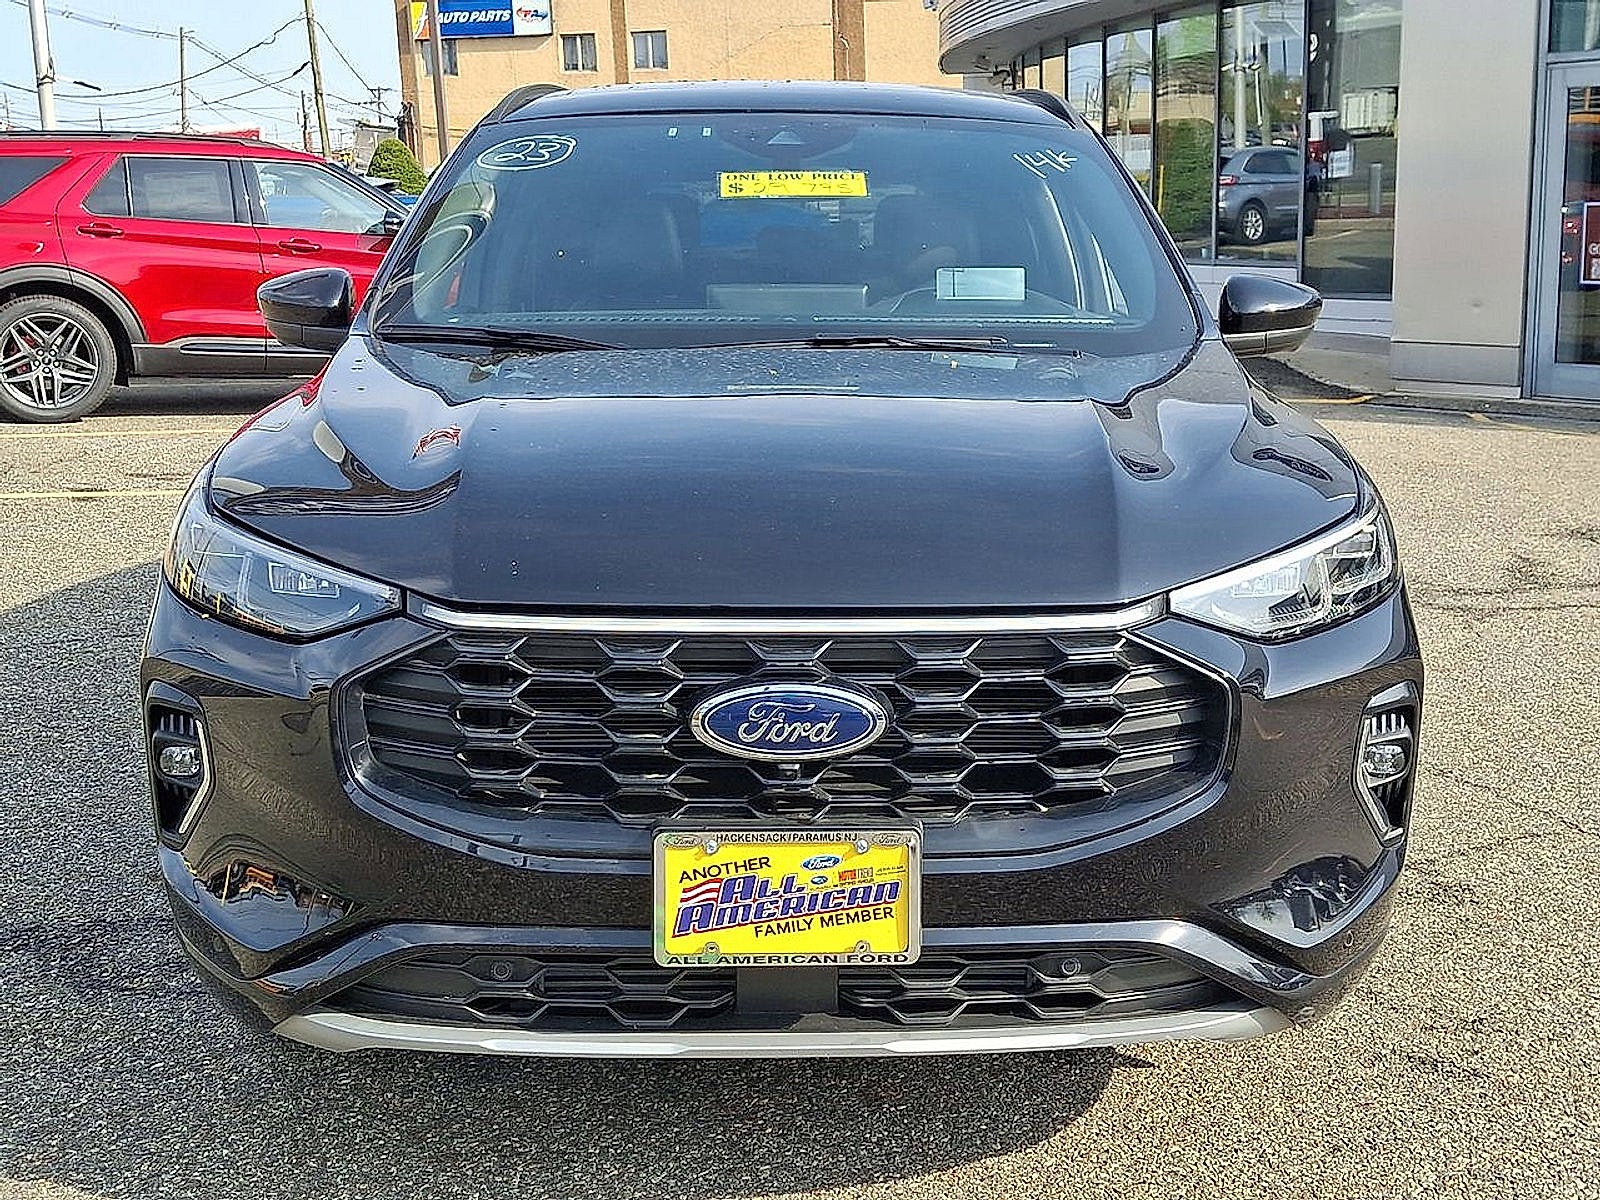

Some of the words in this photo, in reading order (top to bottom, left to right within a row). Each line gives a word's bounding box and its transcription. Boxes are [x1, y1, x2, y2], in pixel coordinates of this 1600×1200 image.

[438, 11, 469, 24] AUTO
[469, 9, 512, 22] PARTS
[494, 141, 561, 162] 23
[726, 173, 760, 181] ONE
[768, 173, 804, 181] LOW
[738, 701, 841, 743] Ford
[844, 832, 859, 842] NJ
[678, 856, 772, 883] ANOTHER
[719, 873, 805, 904] ALL
[676, 880, 901, 934] AMERICAN
[754, 917, 814, 938] FAMILY
[820, 907, 895, 929] MEMBER
[667, 955, 711, 965] ALL
[718, 954, 839, 965] AMERICAN
[845, 953, 909, 964] FORD
